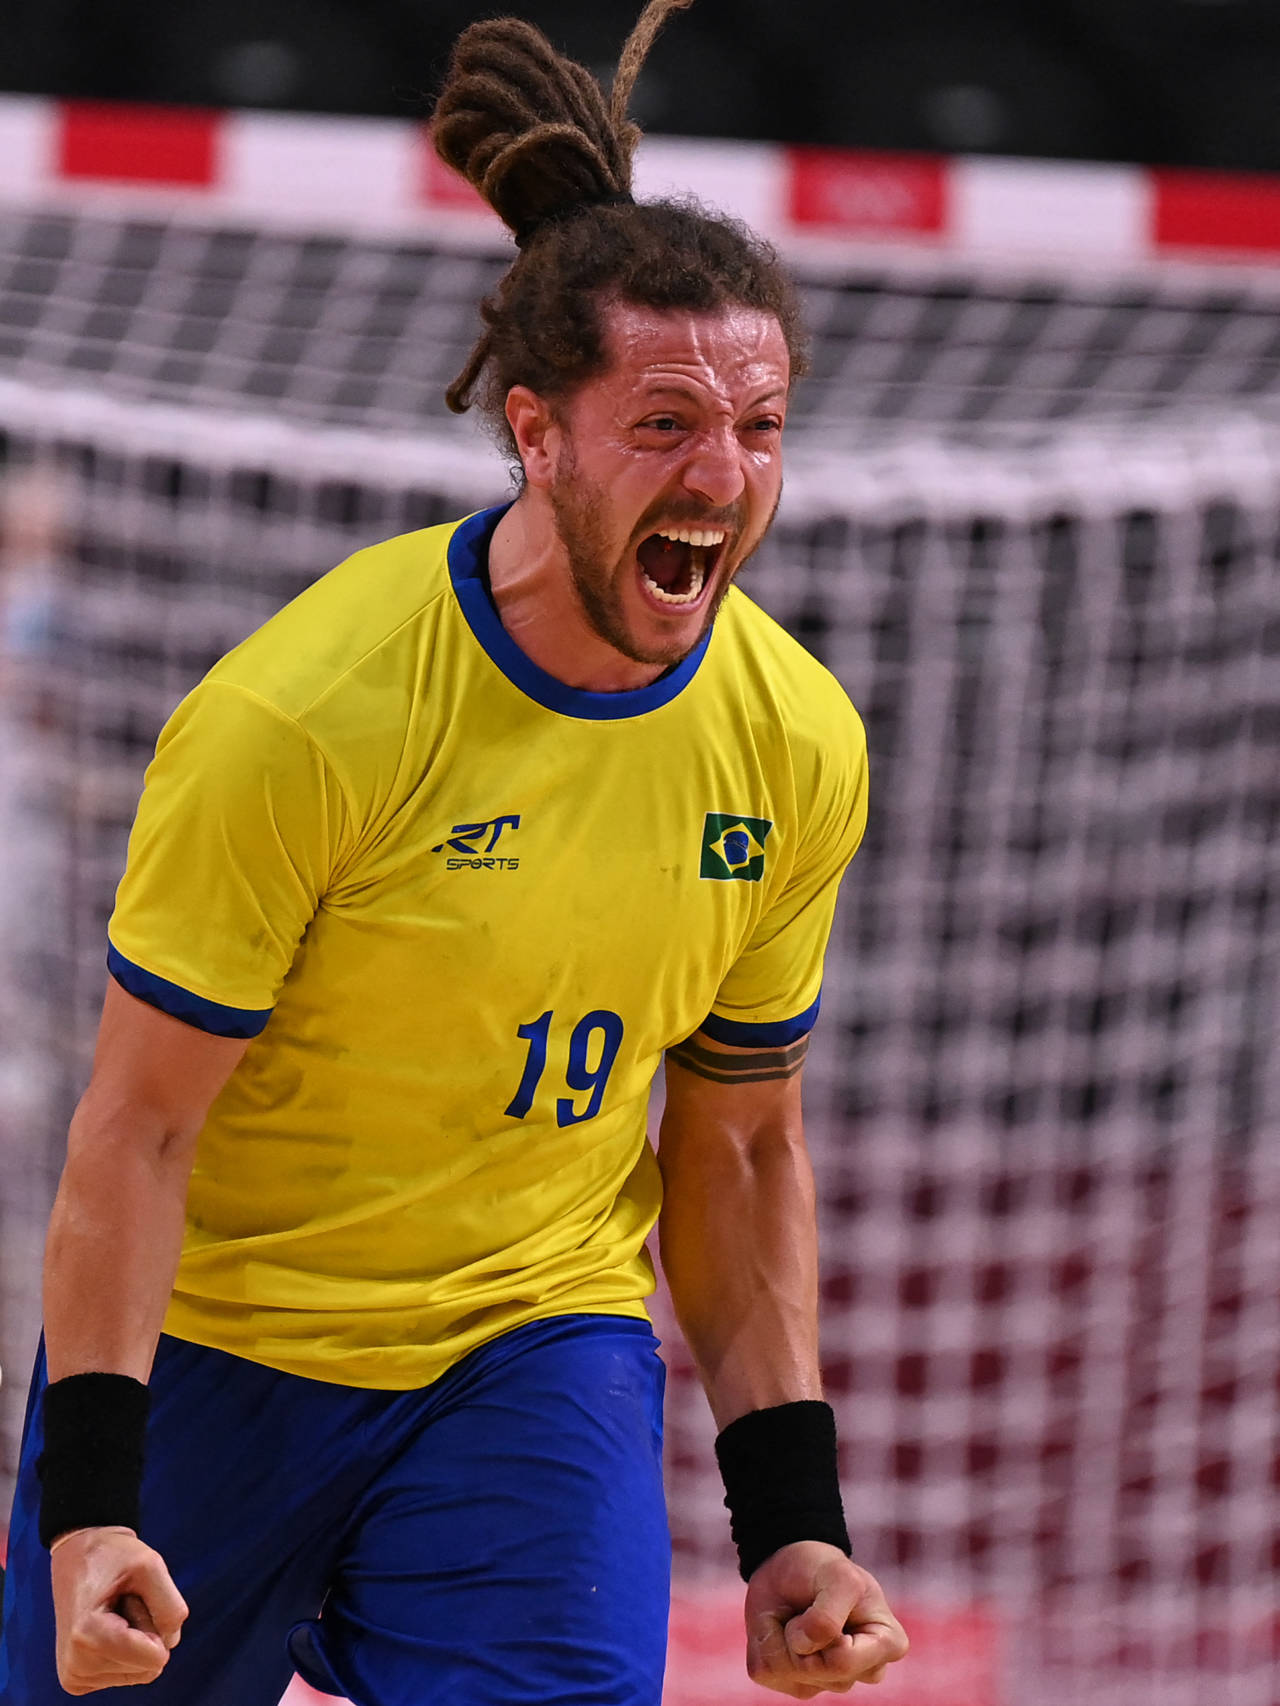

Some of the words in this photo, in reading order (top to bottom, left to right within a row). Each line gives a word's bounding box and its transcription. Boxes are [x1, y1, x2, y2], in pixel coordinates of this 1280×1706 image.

[431, 814, 521, 854] RT
[446, 857, 520, 870] SPORTS
[504, 1009, 624, 1128] 19
